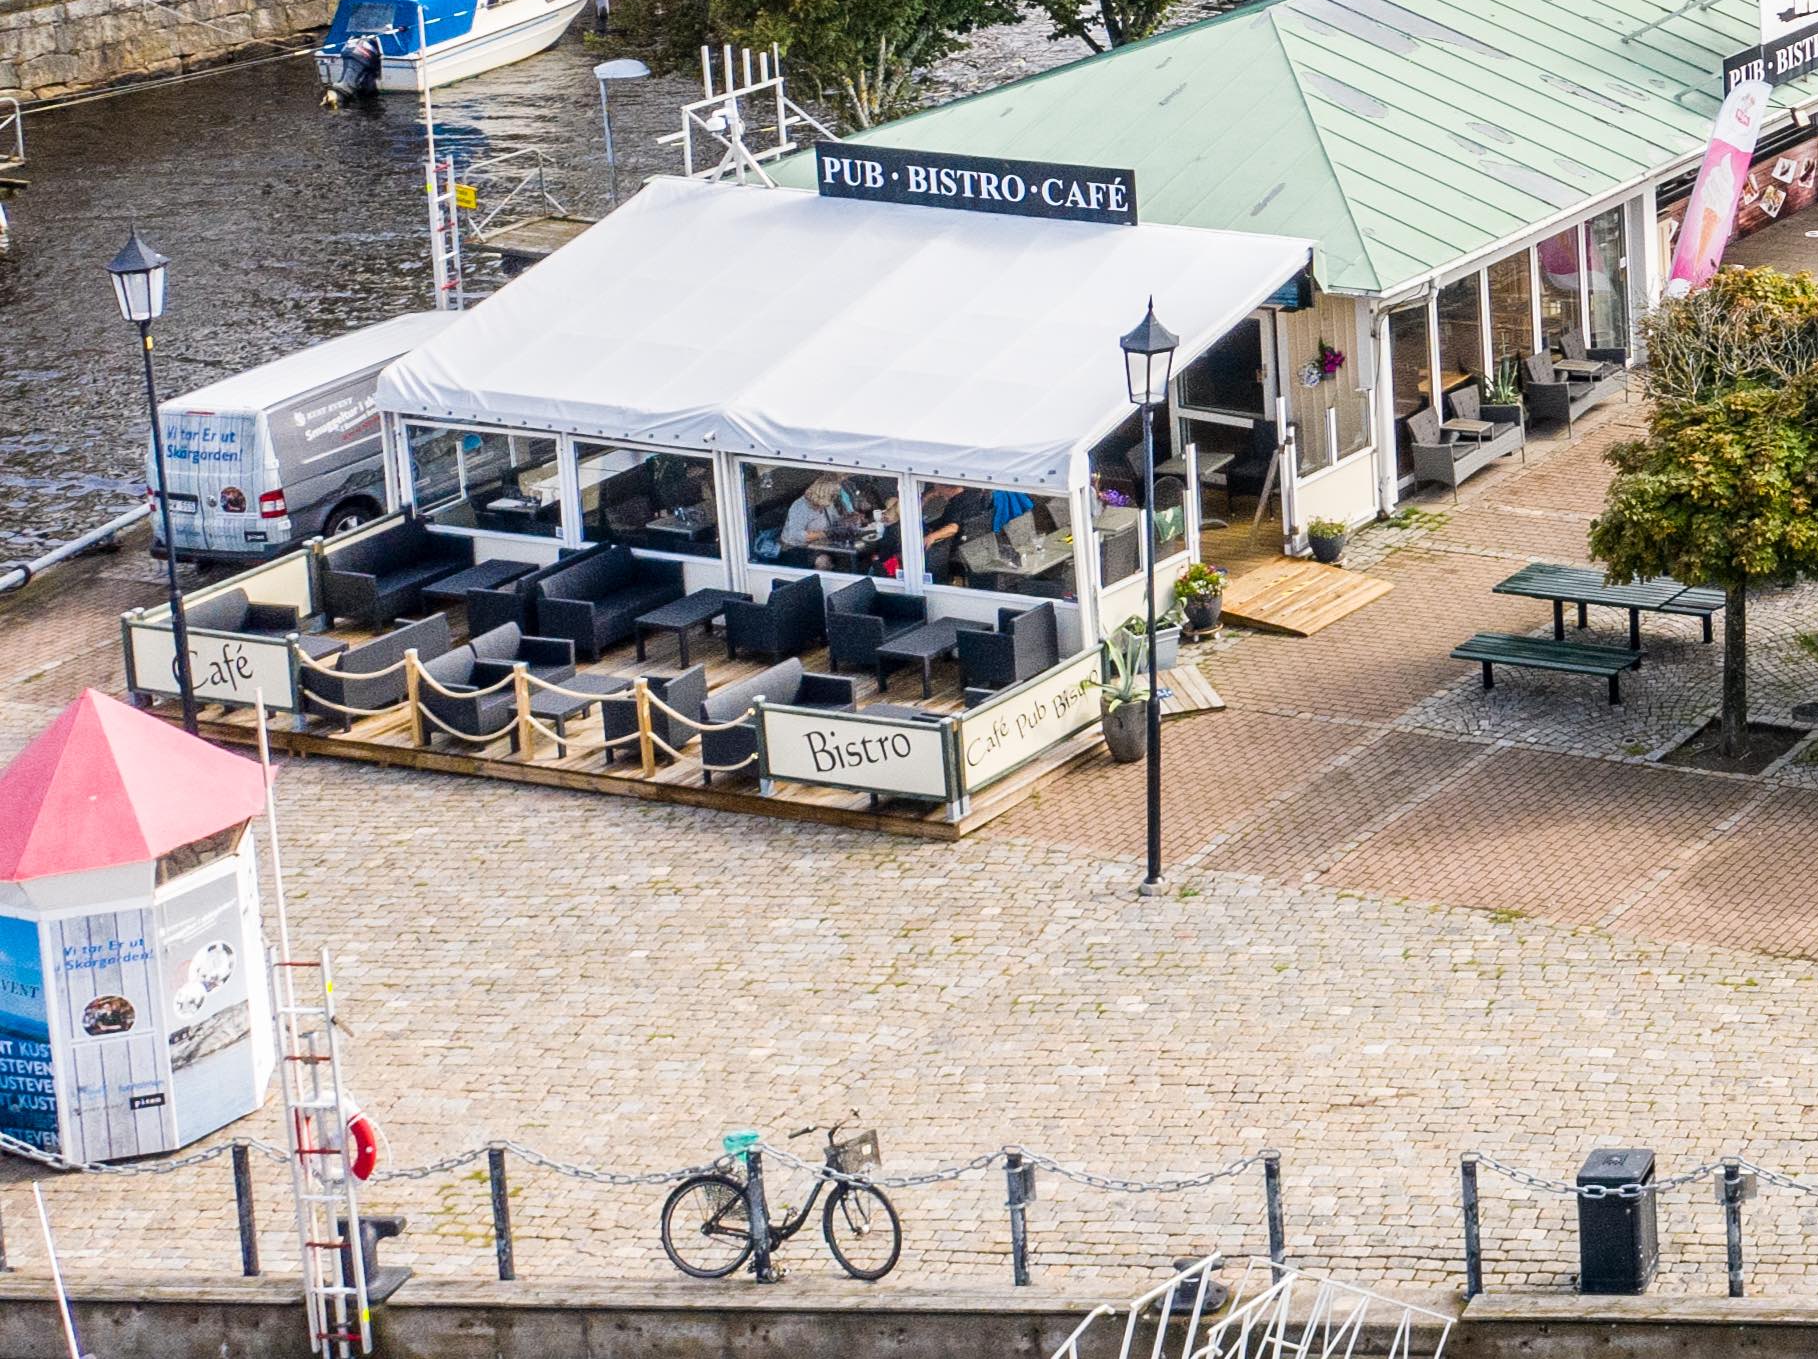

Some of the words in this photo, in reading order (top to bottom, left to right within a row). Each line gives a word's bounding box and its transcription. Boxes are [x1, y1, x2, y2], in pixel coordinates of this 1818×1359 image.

[822, 156, 884, 188] PUB
[1042, 177, 1129, 212] CAFÉ
[166, 425, 178, 440] Vi
[180, 429, 199, 442] tar
[202, 429, 216, 443] Er
[221, 431, 236, 443] ut
[803, 730, 912, 773] Bistro
[966, 715, 1010, 768] Café
[1015, 701, 1047, 738] Pub
[129, 938, 144, 949] ut
